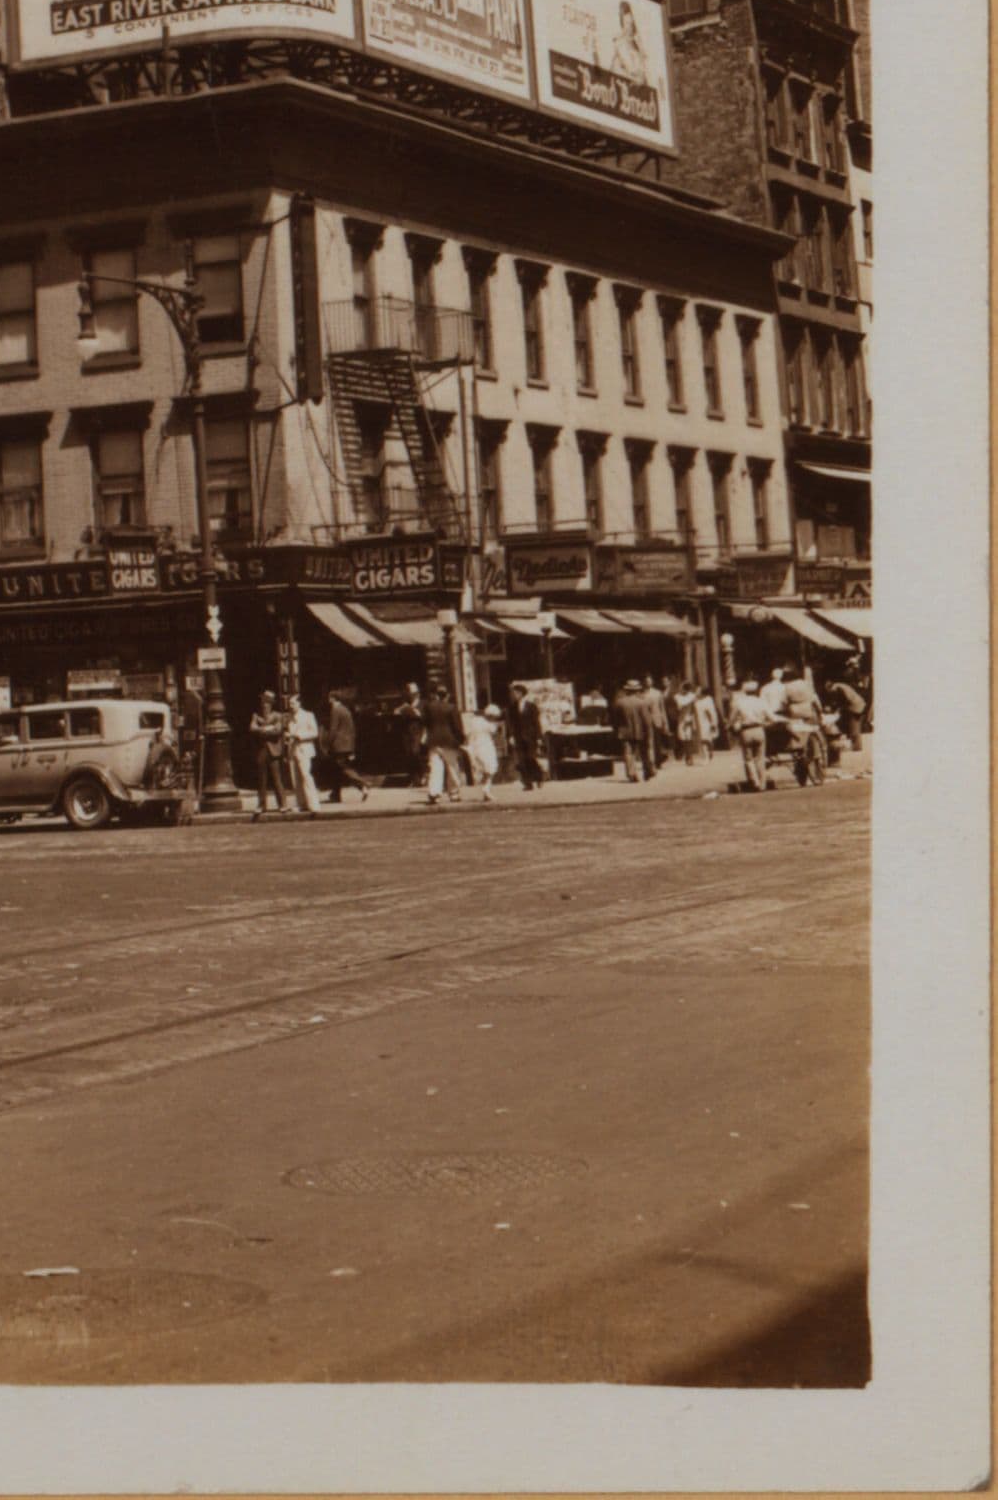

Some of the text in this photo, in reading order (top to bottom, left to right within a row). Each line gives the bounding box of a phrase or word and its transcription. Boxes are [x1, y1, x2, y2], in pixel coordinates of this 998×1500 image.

[52, 3, 104, 33] EAST
[113, 8, 220, 35] CONVENIENT
[578, 63, 617, 109] Bond
[616, 72, 657, 122] Bread
[109, 552, 155, 566] UNITED
[351, 544, 435, 569] UNITED
[1, 571, 106, 597] UNITE
[111, 568, 158, 590] CIGARS
[354, 564, 435, 591] CIGARS
